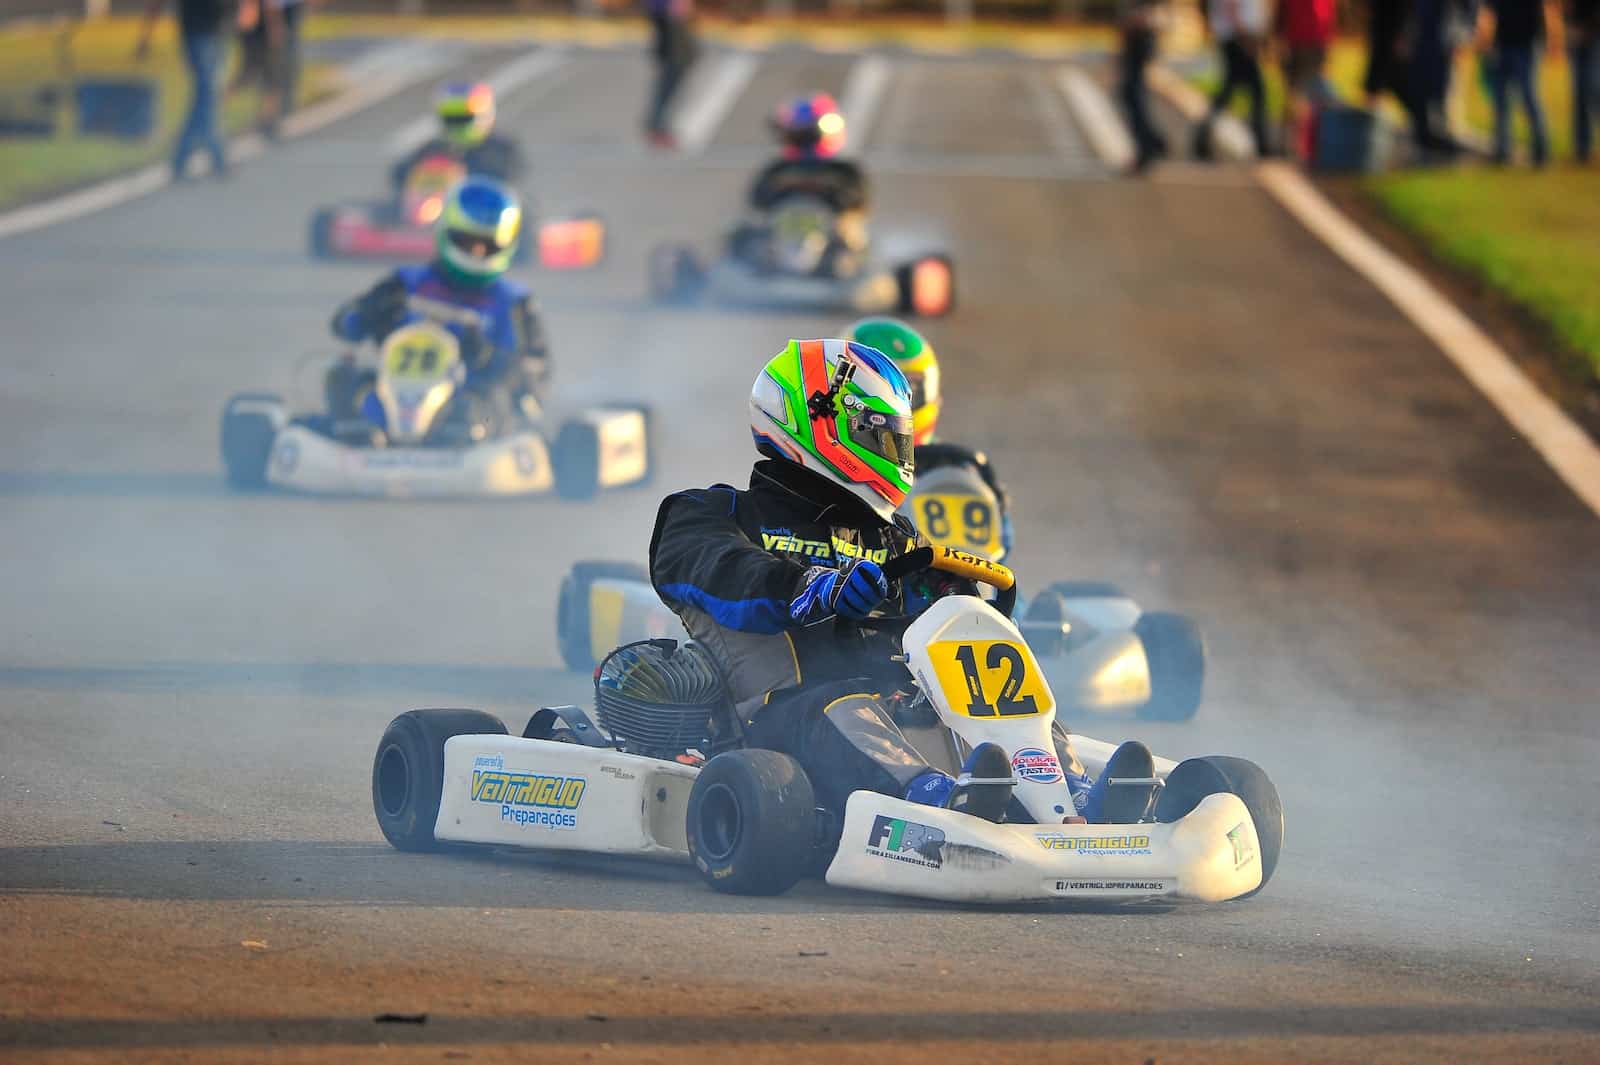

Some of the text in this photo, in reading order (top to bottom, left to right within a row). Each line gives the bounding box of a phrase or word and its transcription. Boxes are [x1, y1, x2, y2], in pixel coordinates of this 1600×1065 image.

[924, 499, 991, 545] 89
[944, 547, 993, 570] Kart
[955, 643, 1039, 717] 12
[471, 770, 586, 809] VENTRIGLIO
[1038, 836, 1150, 849] VENTRIGLIO
